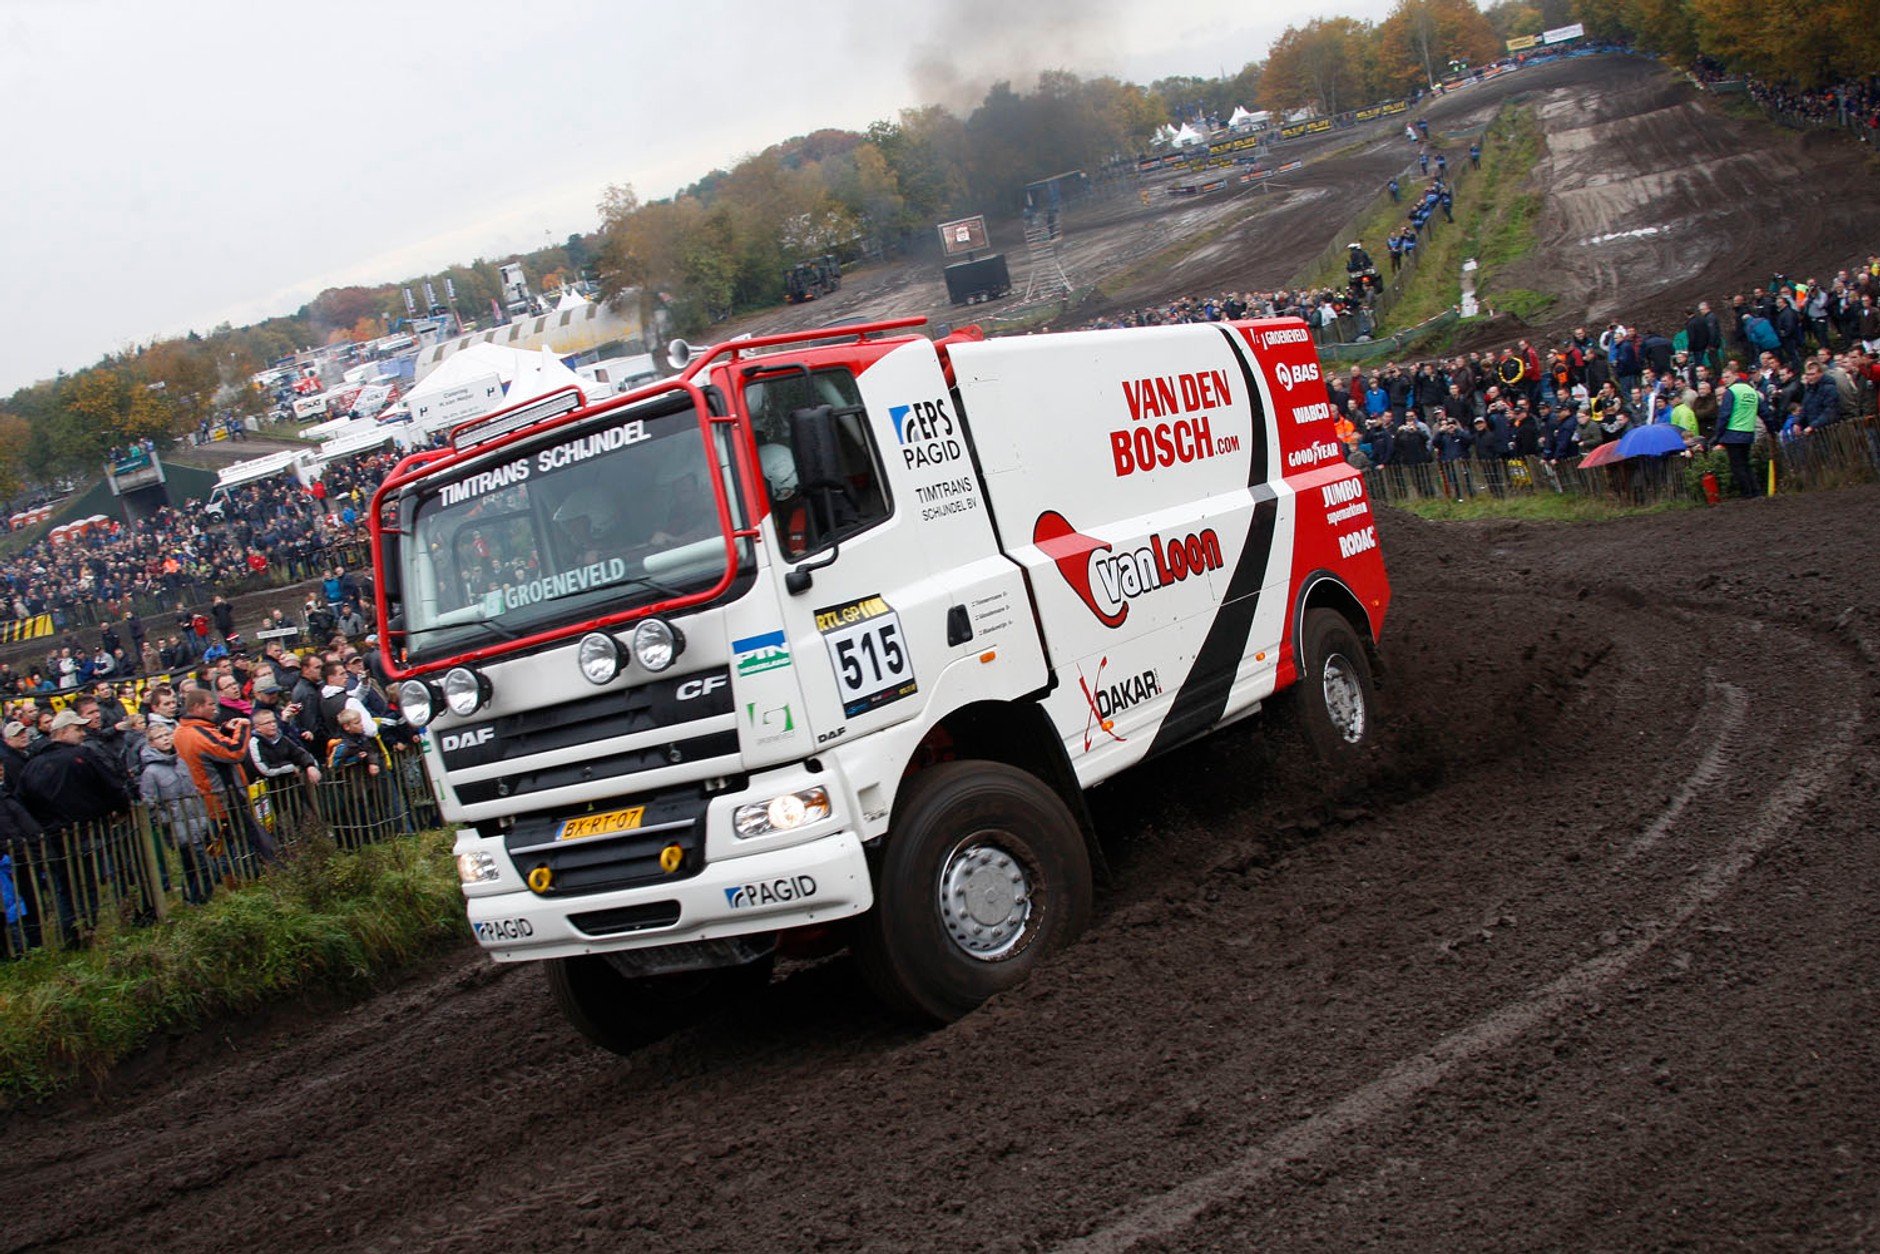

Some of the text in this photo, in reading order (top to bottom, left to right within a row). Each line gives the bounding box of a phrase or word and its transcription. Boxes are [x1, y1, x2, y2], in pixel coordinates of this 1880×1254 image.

[1291, 363, 1319, 383] BAS
[1122, 369, 1233, 421] VAN DEN
[912, 399, 953, 440] EPS
[1292, 402, 1330, 425] WABCO
[438, 419, 652, 507] TIMTRANS SCHIJNDEL
[902, 440, 961, 470] PAGID
[915, 476, 973, 504] TIMTRANS
[1321, 477, 1362, 508] JUMBO
[922, 497, 977, 521] SCHIJNDEL BV
[1338, 525, 1376, 559] RODAC
[504, 558, 625, 610] GROENEVELD
[835, 624, 905, 690] 515
[676, 674, 728, 701] CF
[1096, 669, 1159, 719] DAKAR
[442, 726, 495, 753] DAF
[817, 726, 847, 744] DAF
[745, 875, 816, 906] PAGID
[484, 917, 534, 941] PAGID
